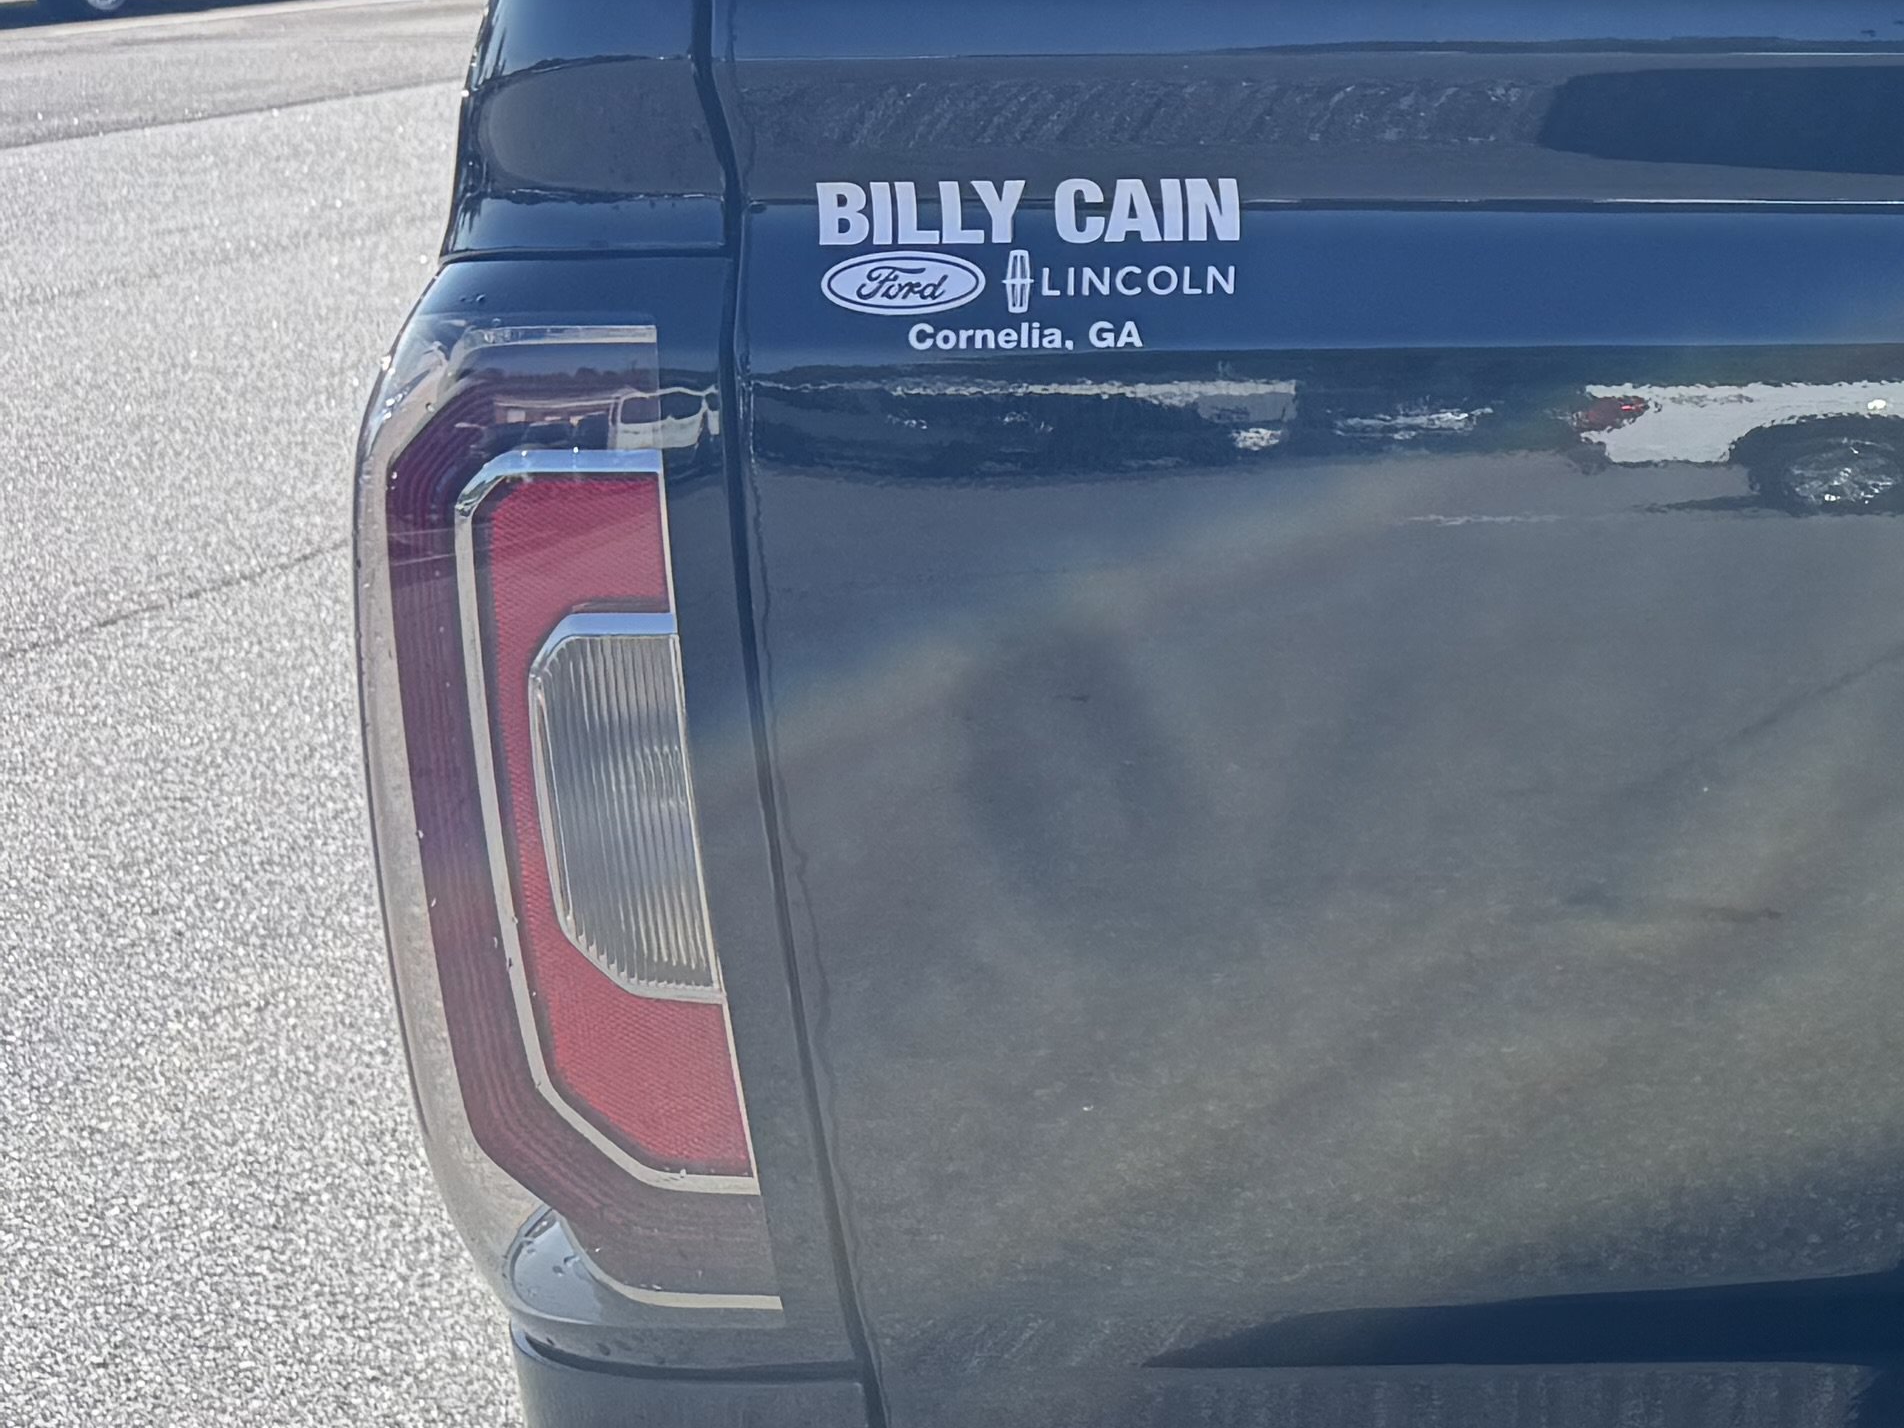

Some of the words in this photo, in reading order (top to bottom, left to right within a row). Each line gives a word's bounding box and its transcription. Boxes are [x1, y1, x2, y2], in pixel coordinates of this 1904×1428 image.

[815, 178, 1027, 246] BILLY
[1053, 177, 1241, 244] CAIN
[855, 263, 950, 301] Ford
[1040, 264, 1237, 297] LINCOLN
[907, 322, 1075, 351] Cornelia,
[1087, 320, 1144, 349] GA
